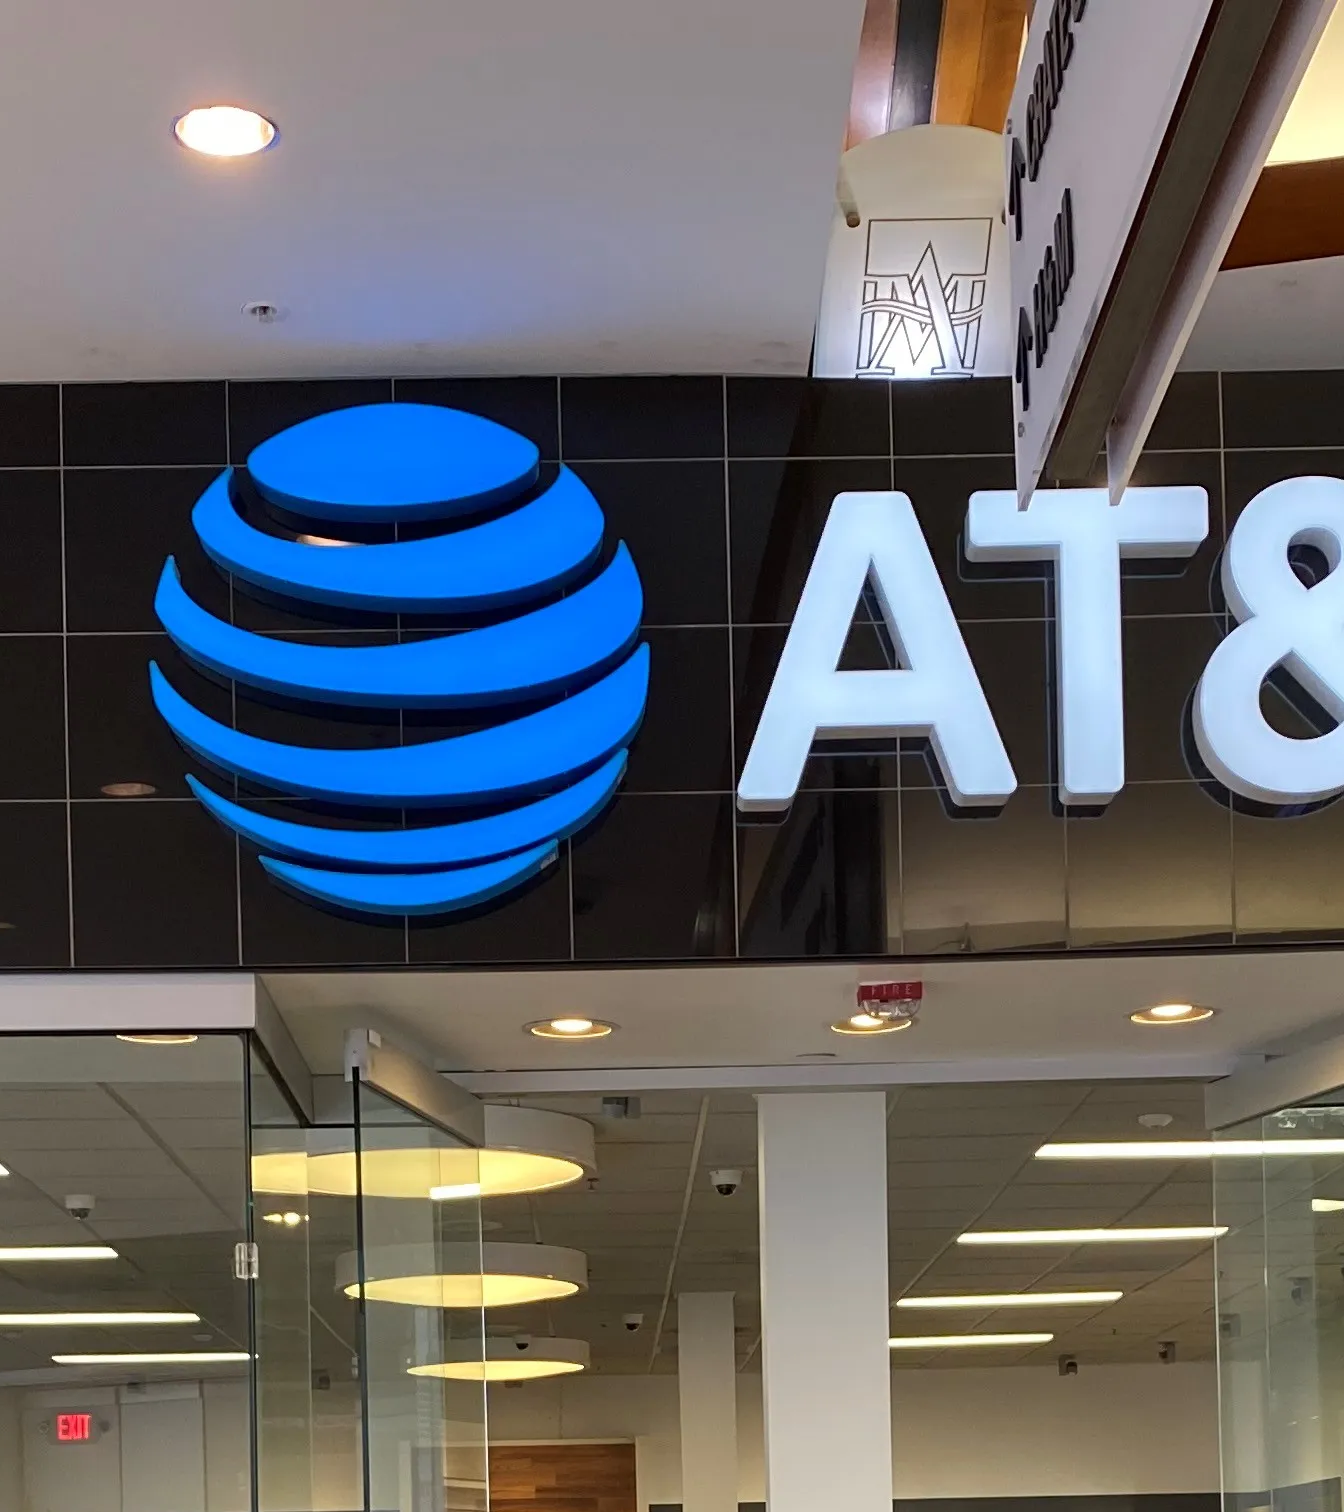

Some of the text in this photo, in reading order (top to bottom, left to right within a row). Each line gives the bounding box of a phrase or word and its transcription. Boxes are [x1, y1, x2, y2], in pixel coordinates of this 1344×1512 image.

[1033, 188, 1076, 369] H&M
[871, 984, 913, 996] FIRE
[57, 1414, 90, 1440] EXIT
